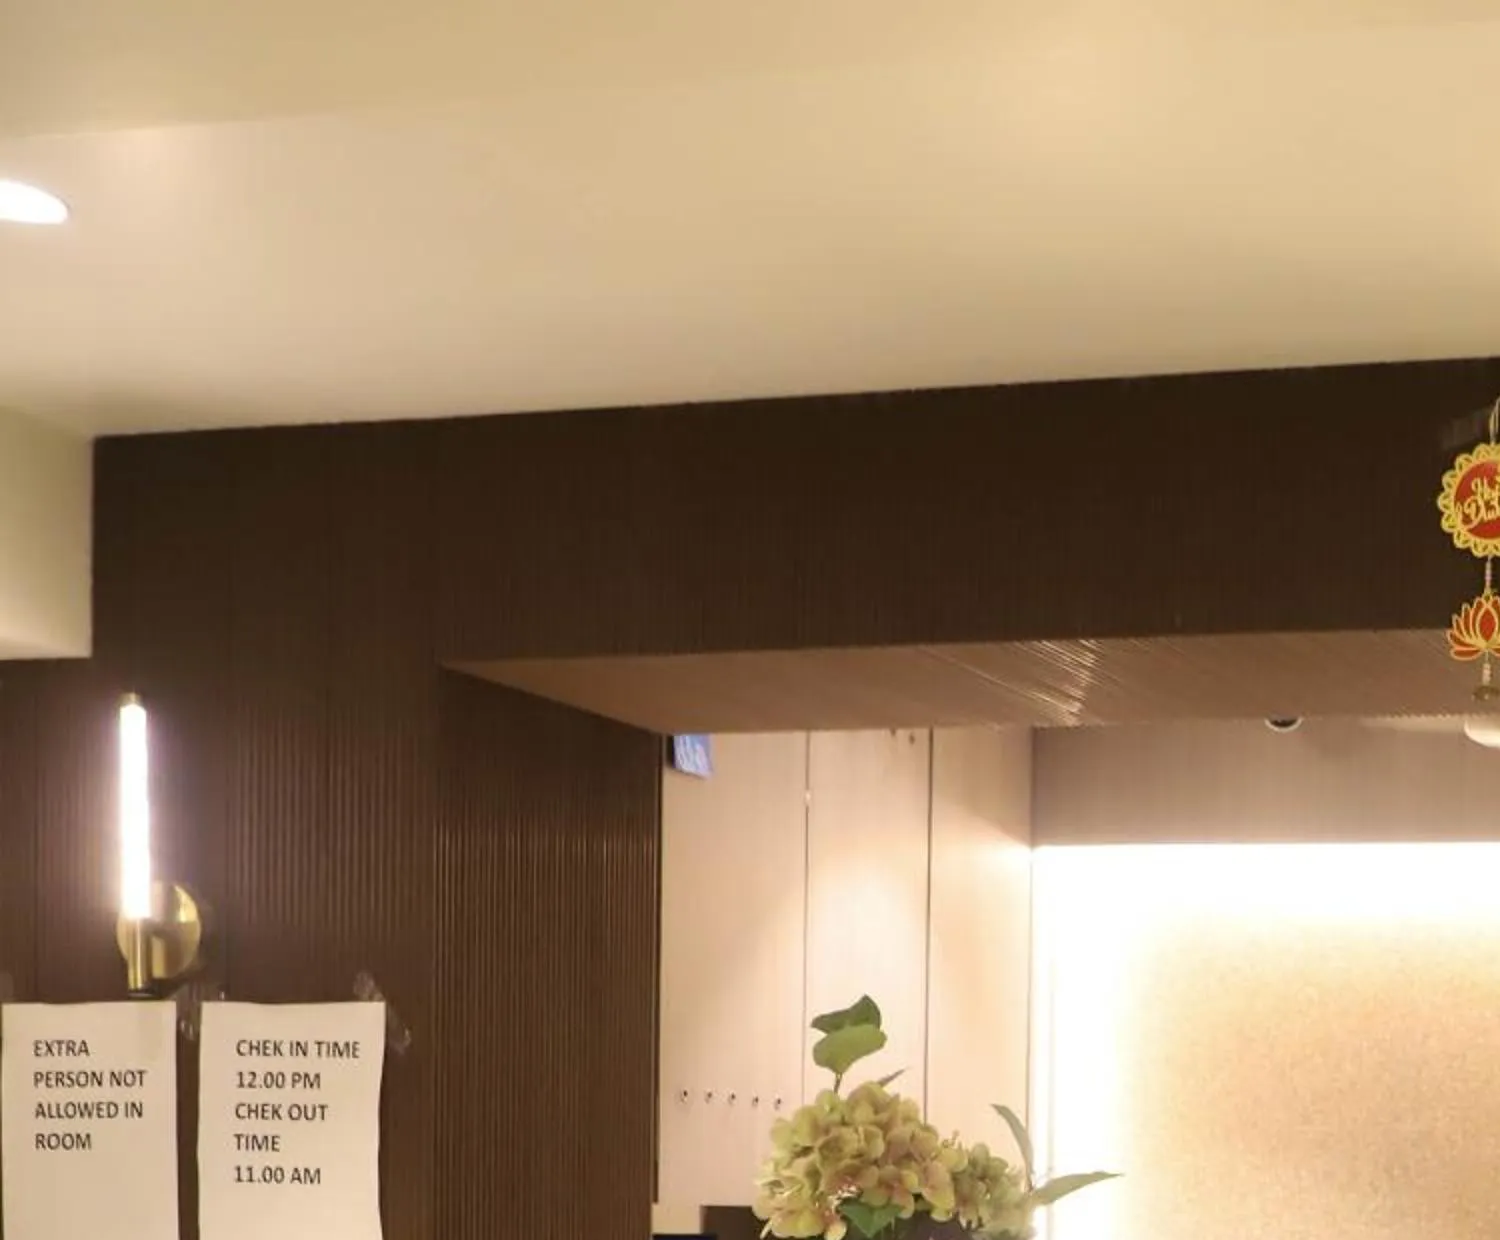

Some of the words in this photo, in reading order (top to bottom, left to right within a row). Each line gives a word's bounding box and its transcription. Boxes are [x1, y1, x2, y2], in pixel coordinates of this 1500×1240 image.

[33, 1039, 90, 1058] EXTRA
[235, 1039, 283, 1058] CHEK
[289, 1040, 309, 1058] IN
[314, 1040, 361, 1059] TIME
[33, 1070, 103, 1089] PERSON
[109, 1069, 148, 1088] NOT
[236, 1070, 286, 1090] 12.00
[291, 1071, 321, 1090] PM
[34, 1101, 119, 1120] ALLOWED
[125, 1101, 144, 1119] IN
[234, 1102, 282, 1121] CHEK
[288, 1103, 329, 1122] OUT
[34, 1132, 92, 1151] ROOM
[233, 1132, 281, 1153] TIME
[234, 1164, 285, 1185] 11.00
[290, 1166, 321, 1185] AM
